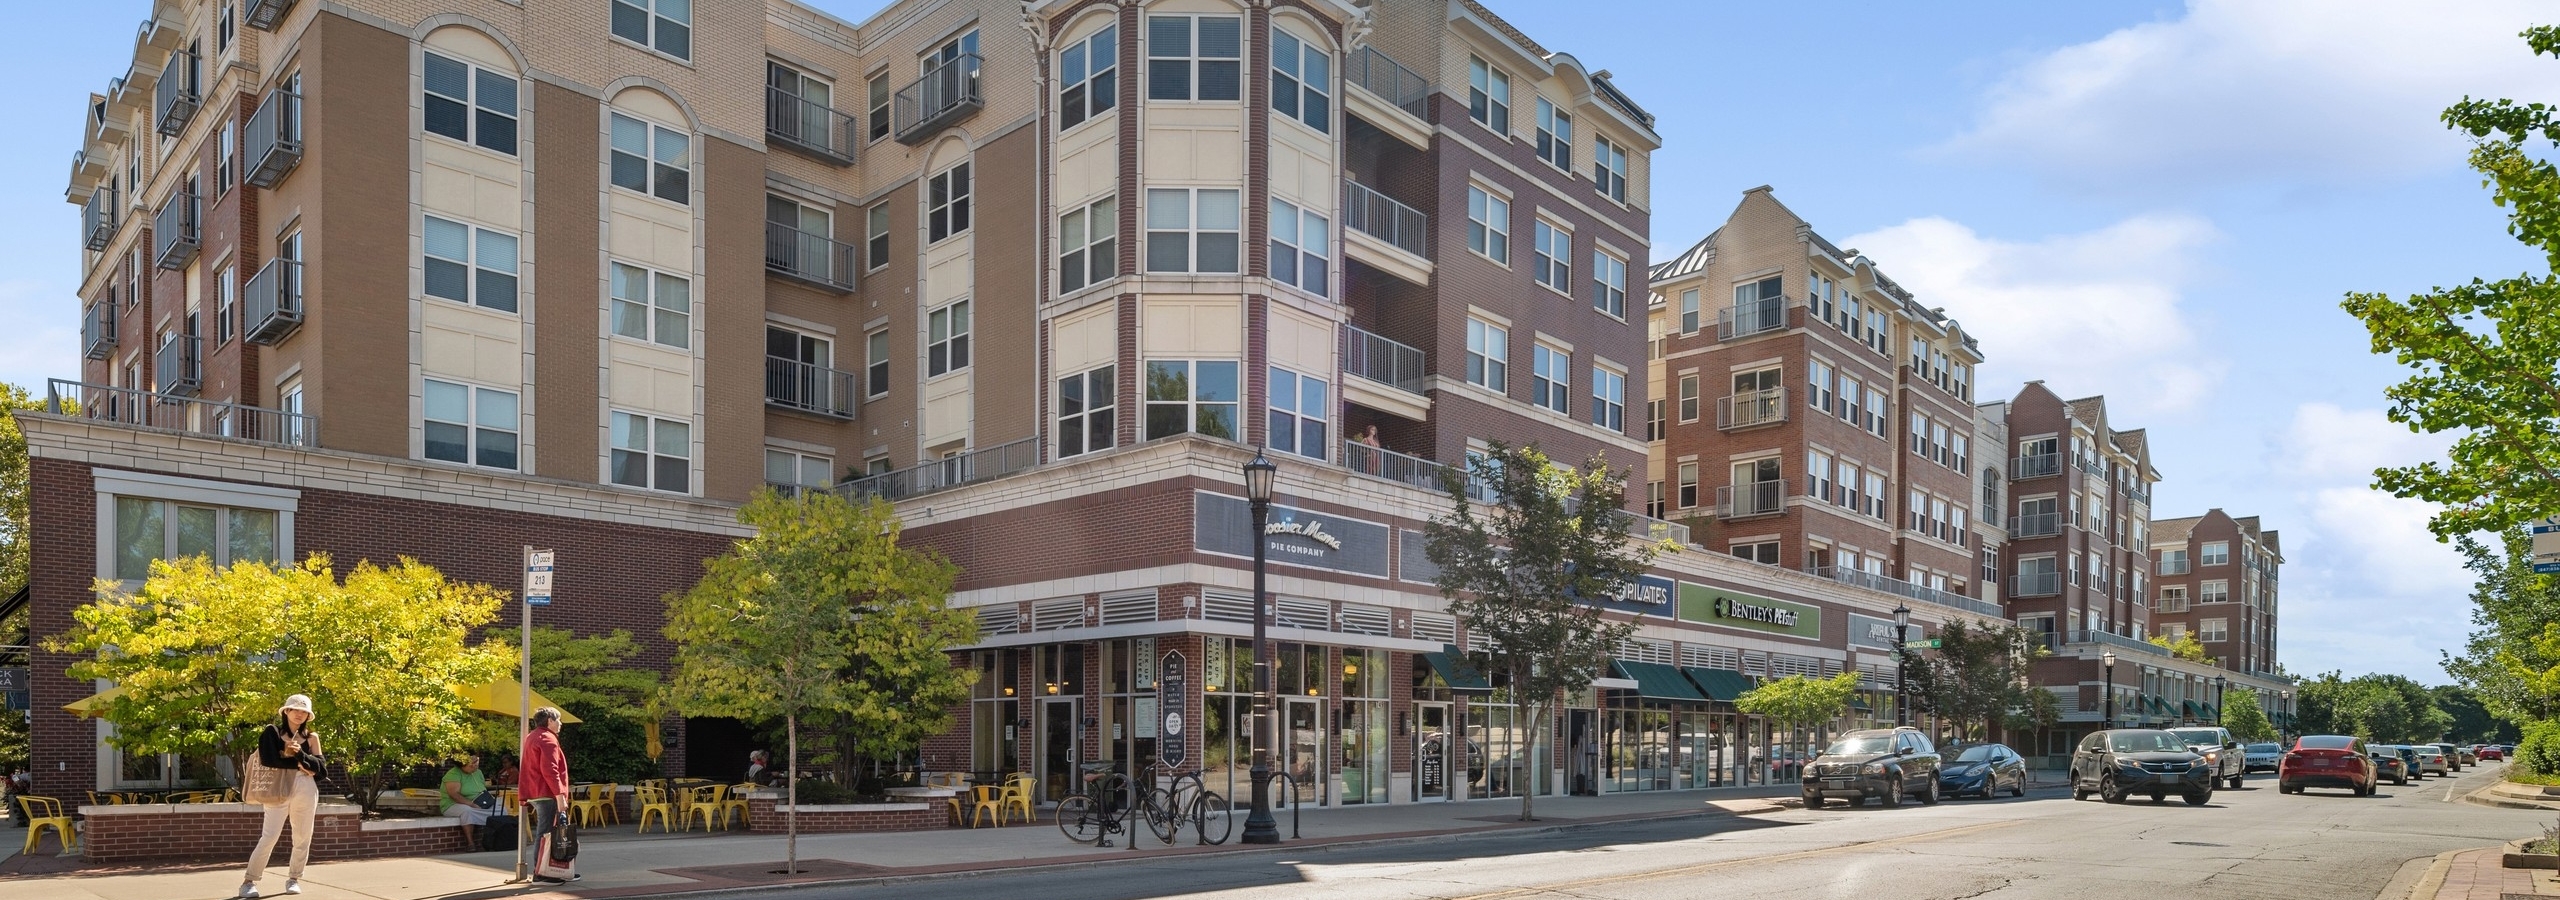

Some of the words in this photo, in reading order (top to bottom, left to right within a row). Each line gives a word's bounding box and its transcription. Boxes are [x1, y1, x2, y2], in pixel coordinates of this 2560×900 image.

[1265, 513, 1302, 535] oosier
[1302, 520, 1341, 549] Mama
[1271, 542, 1284, 551] PIE
[1287, 544, 1324, 557] COMPANY
[535, 576, 545, 585] 213
[1627, 582, 1667, 604] PILATES
[1731, 600, 1773, 623] BENTLEY'S
[1774, 607, 1799, 627] PETstuff
[1906, 640, 1932, 648] MADISON
